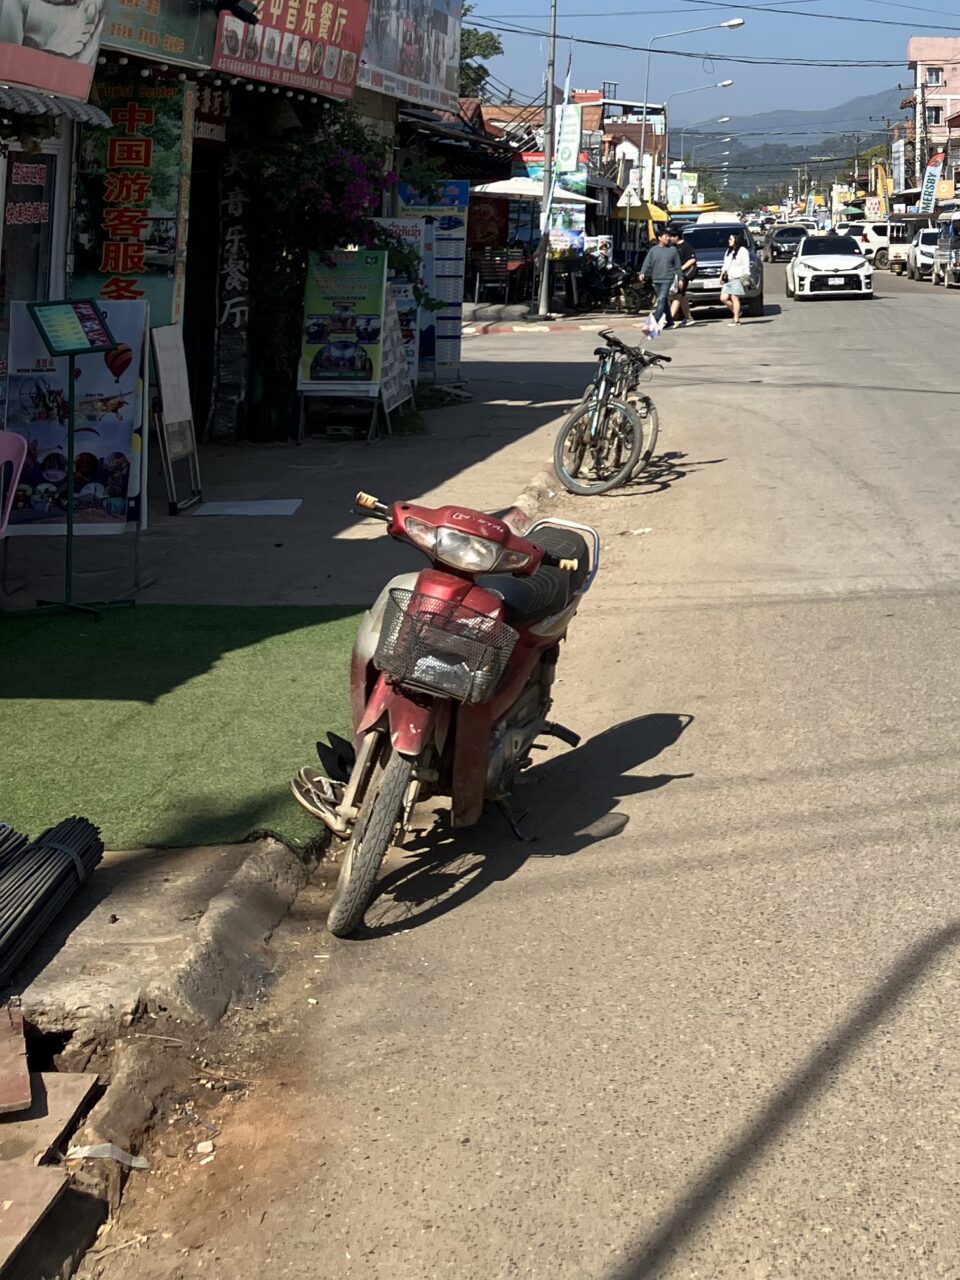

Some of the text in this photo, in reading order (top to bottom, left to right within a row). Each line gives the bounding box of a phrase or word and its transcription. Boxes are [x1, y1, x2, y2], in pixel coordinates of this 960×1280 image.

[98, 102, 154, 300] 中国游客服务
[921, 171, 938, 213] MERSBY
